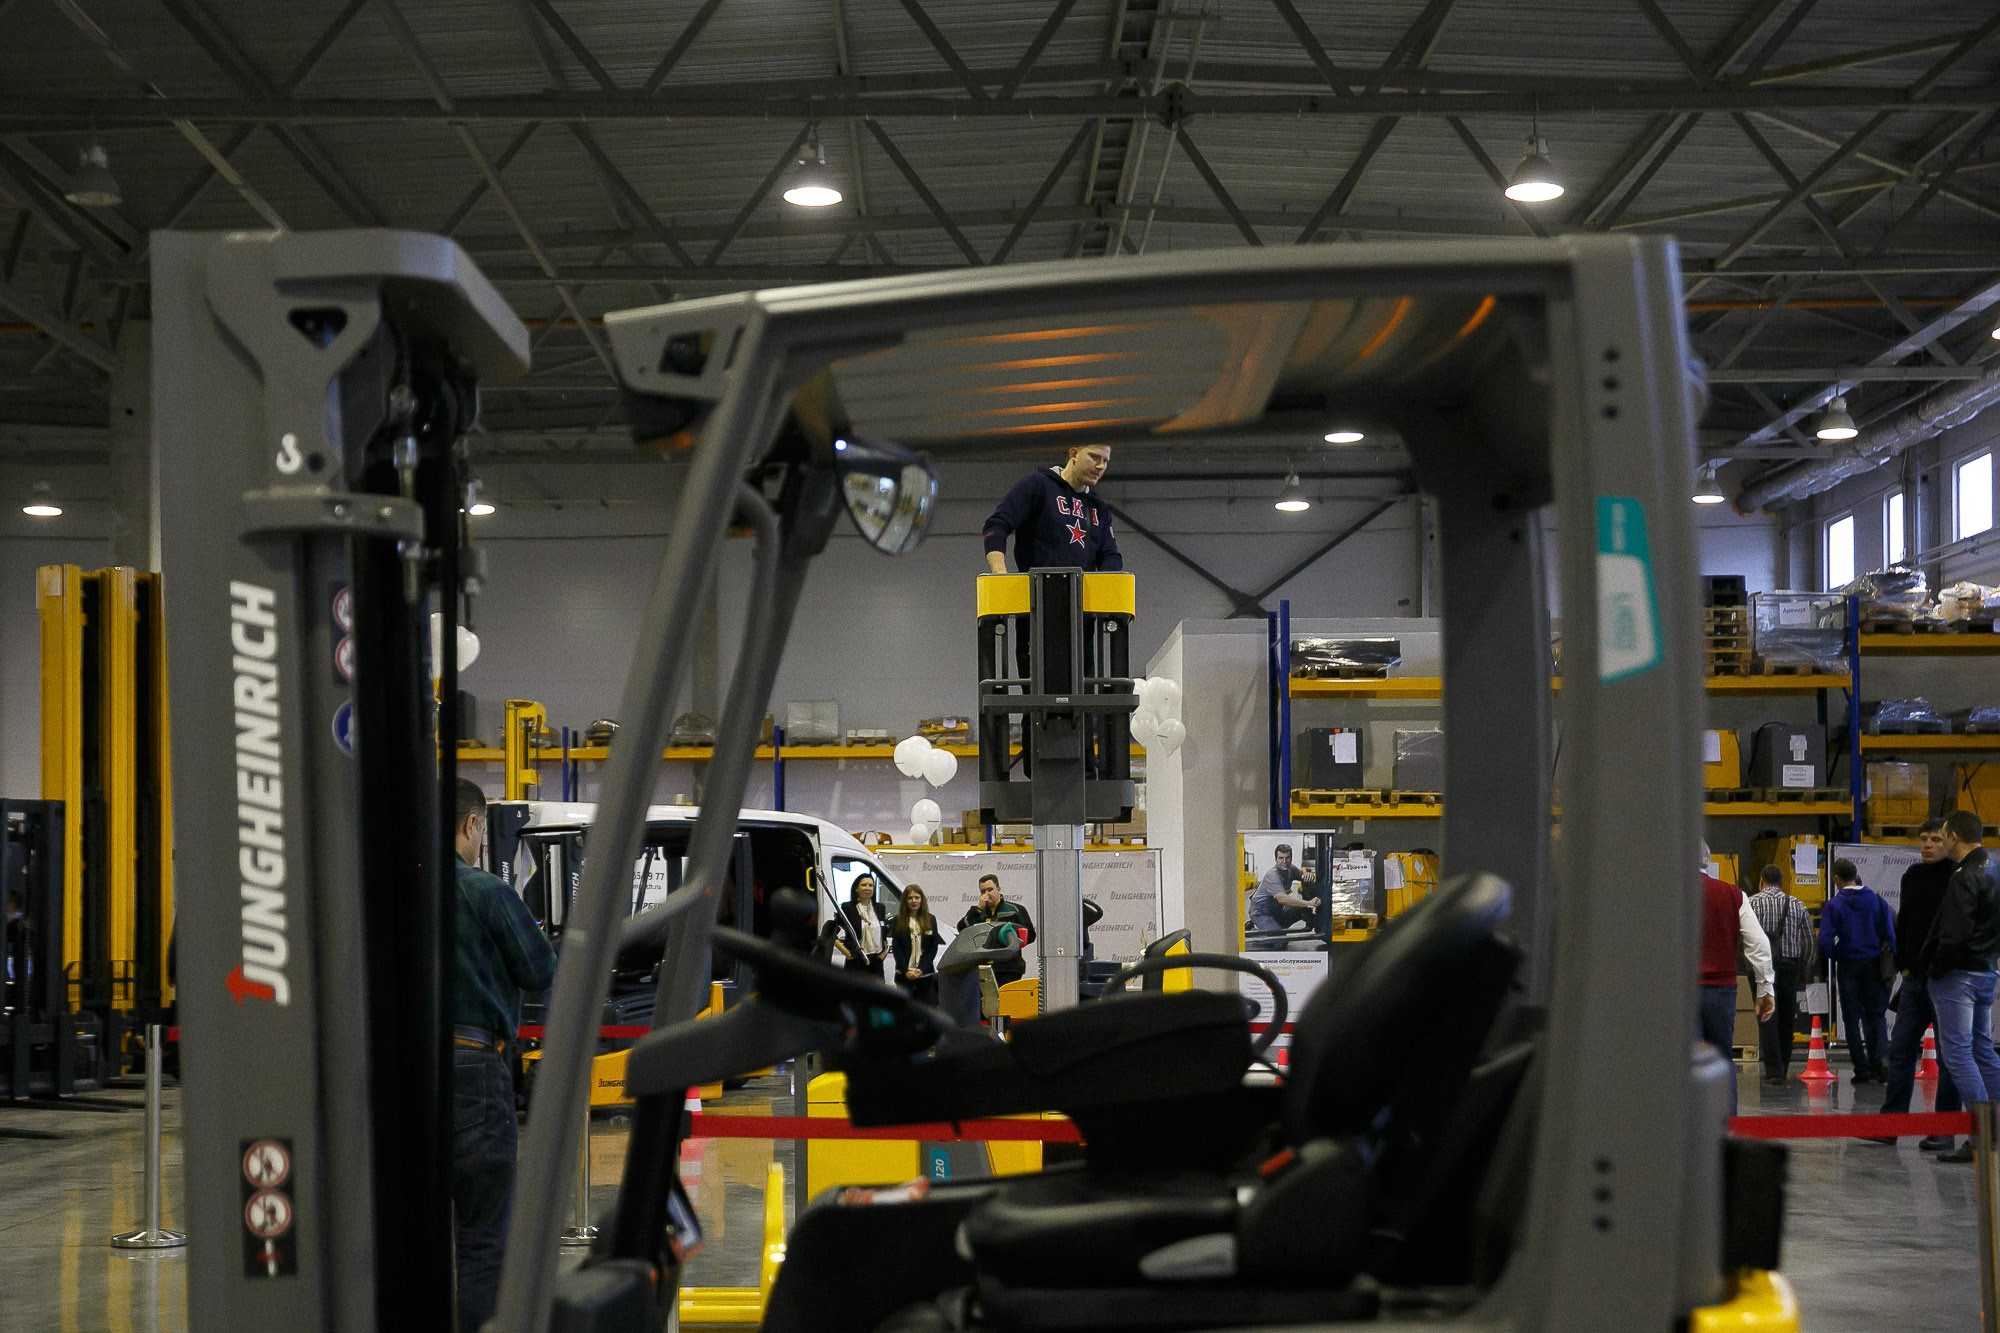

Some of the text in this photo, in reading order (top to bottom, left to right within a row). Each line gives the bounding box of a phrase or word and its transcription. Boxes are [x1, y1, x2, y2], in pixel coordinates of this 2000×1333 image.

[228, 580, 291, 1006] JUNGHEINRICH
[922, 862, 984, 871] JUNGHEINRICH
[996, 861, 1036, 871] JUNGHEIN
[1082, 861, 1133, 870] NGHEINRICH
[1089, 924, 1135, 932] GHEINRICH
[935, 1158, 945, 1179] 120
